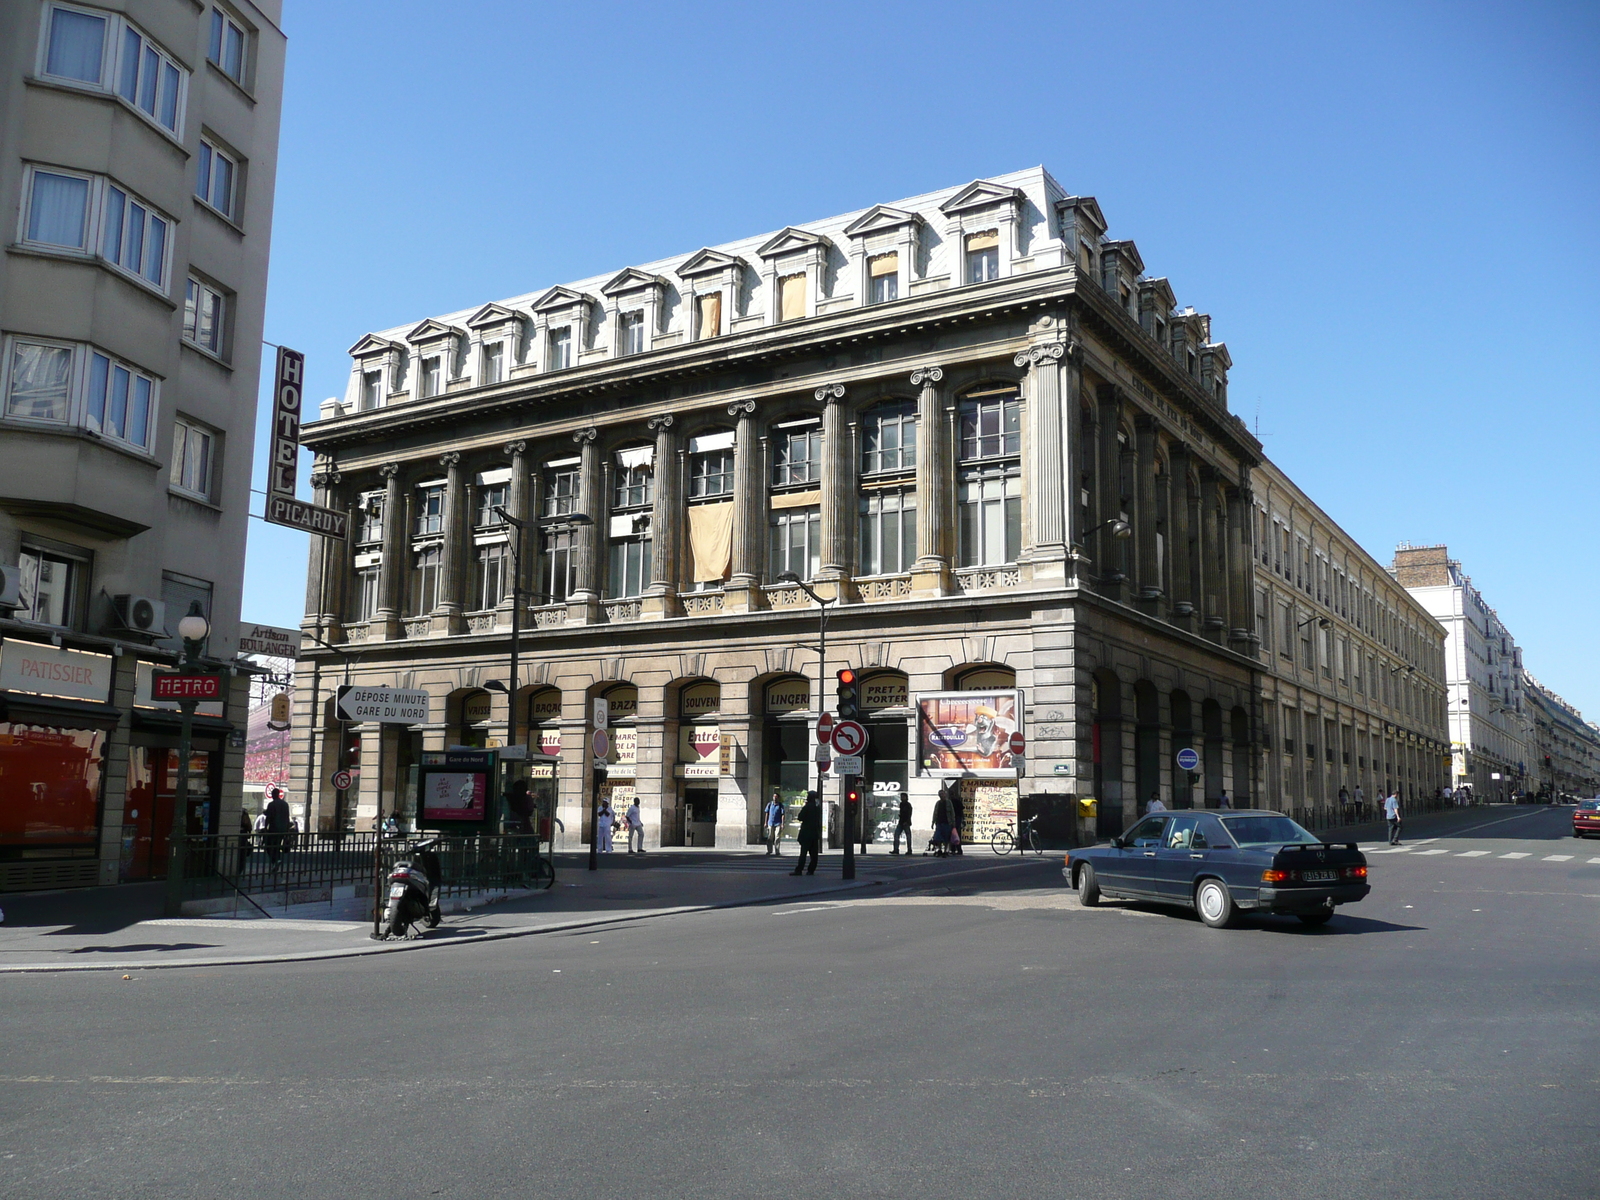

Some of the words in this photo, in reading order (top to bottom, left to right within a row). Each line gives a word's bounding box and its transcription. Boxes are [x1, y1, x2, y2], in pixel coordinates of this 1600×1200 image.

[274, 355, 302, 495] HOTEL
[274, 500, 345, 534] PICARDY
[251, 626, 290, 643] Artisan
[239, 637, 297, 657] BOULANGER
[20, 658, 94, 686] PATISSIER
[159, 678, 216, 695] METRO
[868, 685, 895, 694] PRET
[355, 690, 390, 703] DÉPOSE
[393, 693, 427, 705] MINUTE
[356, 706, 380, 716] GARE
[384, 707, 397, 717] DU
[400, 708, 425, 719] NORD
[873, 781, 901, 791] DVD
